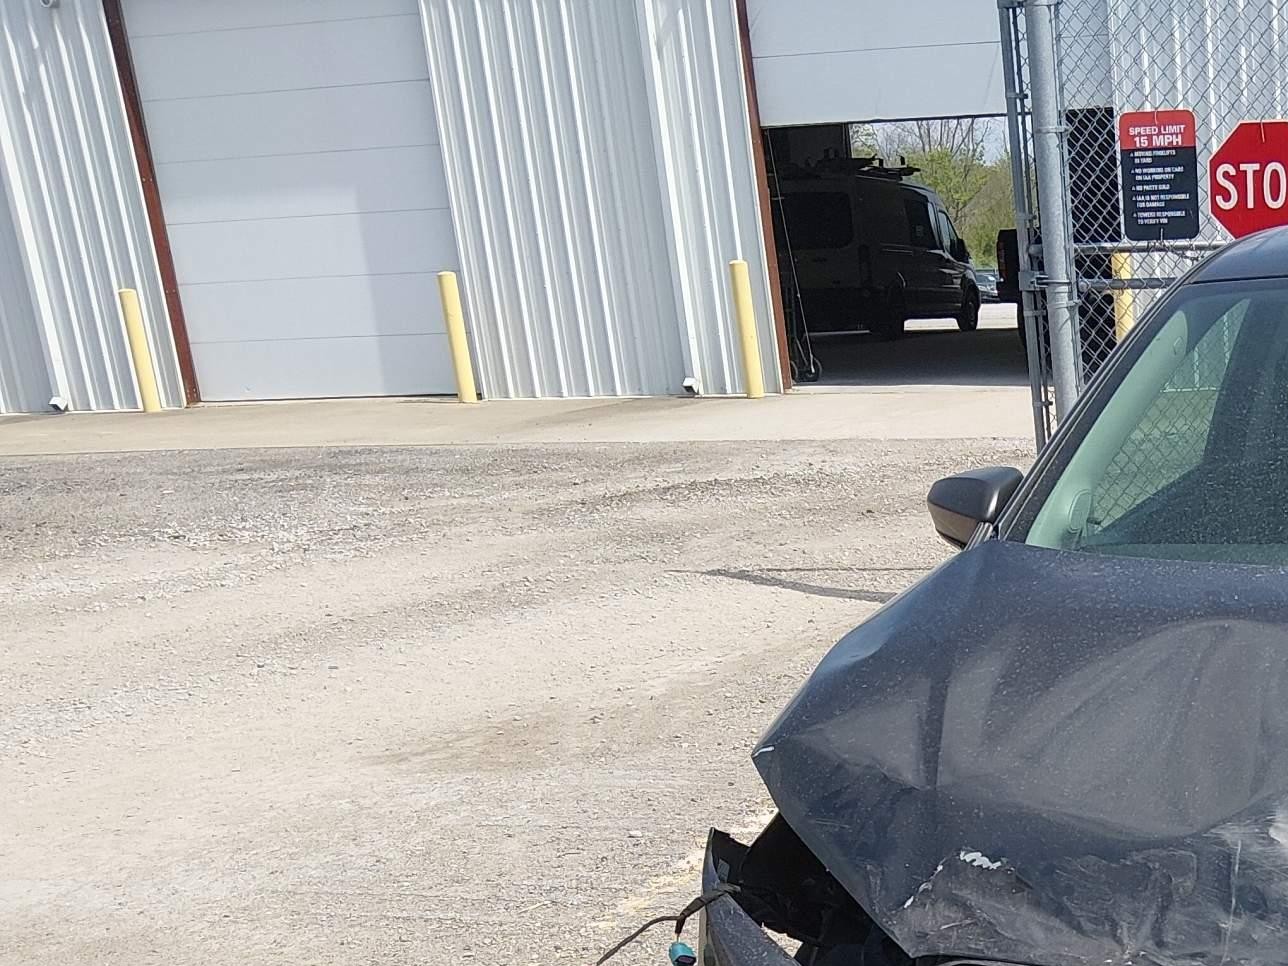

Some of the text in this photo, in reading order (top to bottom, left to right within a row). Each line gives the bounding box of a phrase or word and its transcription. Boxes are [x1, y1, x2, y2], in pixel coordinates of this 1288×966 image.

[1129, 124, 1186, 136] SPEED LIMIT
[1134, 134, 1182, 147] 15 MPH
